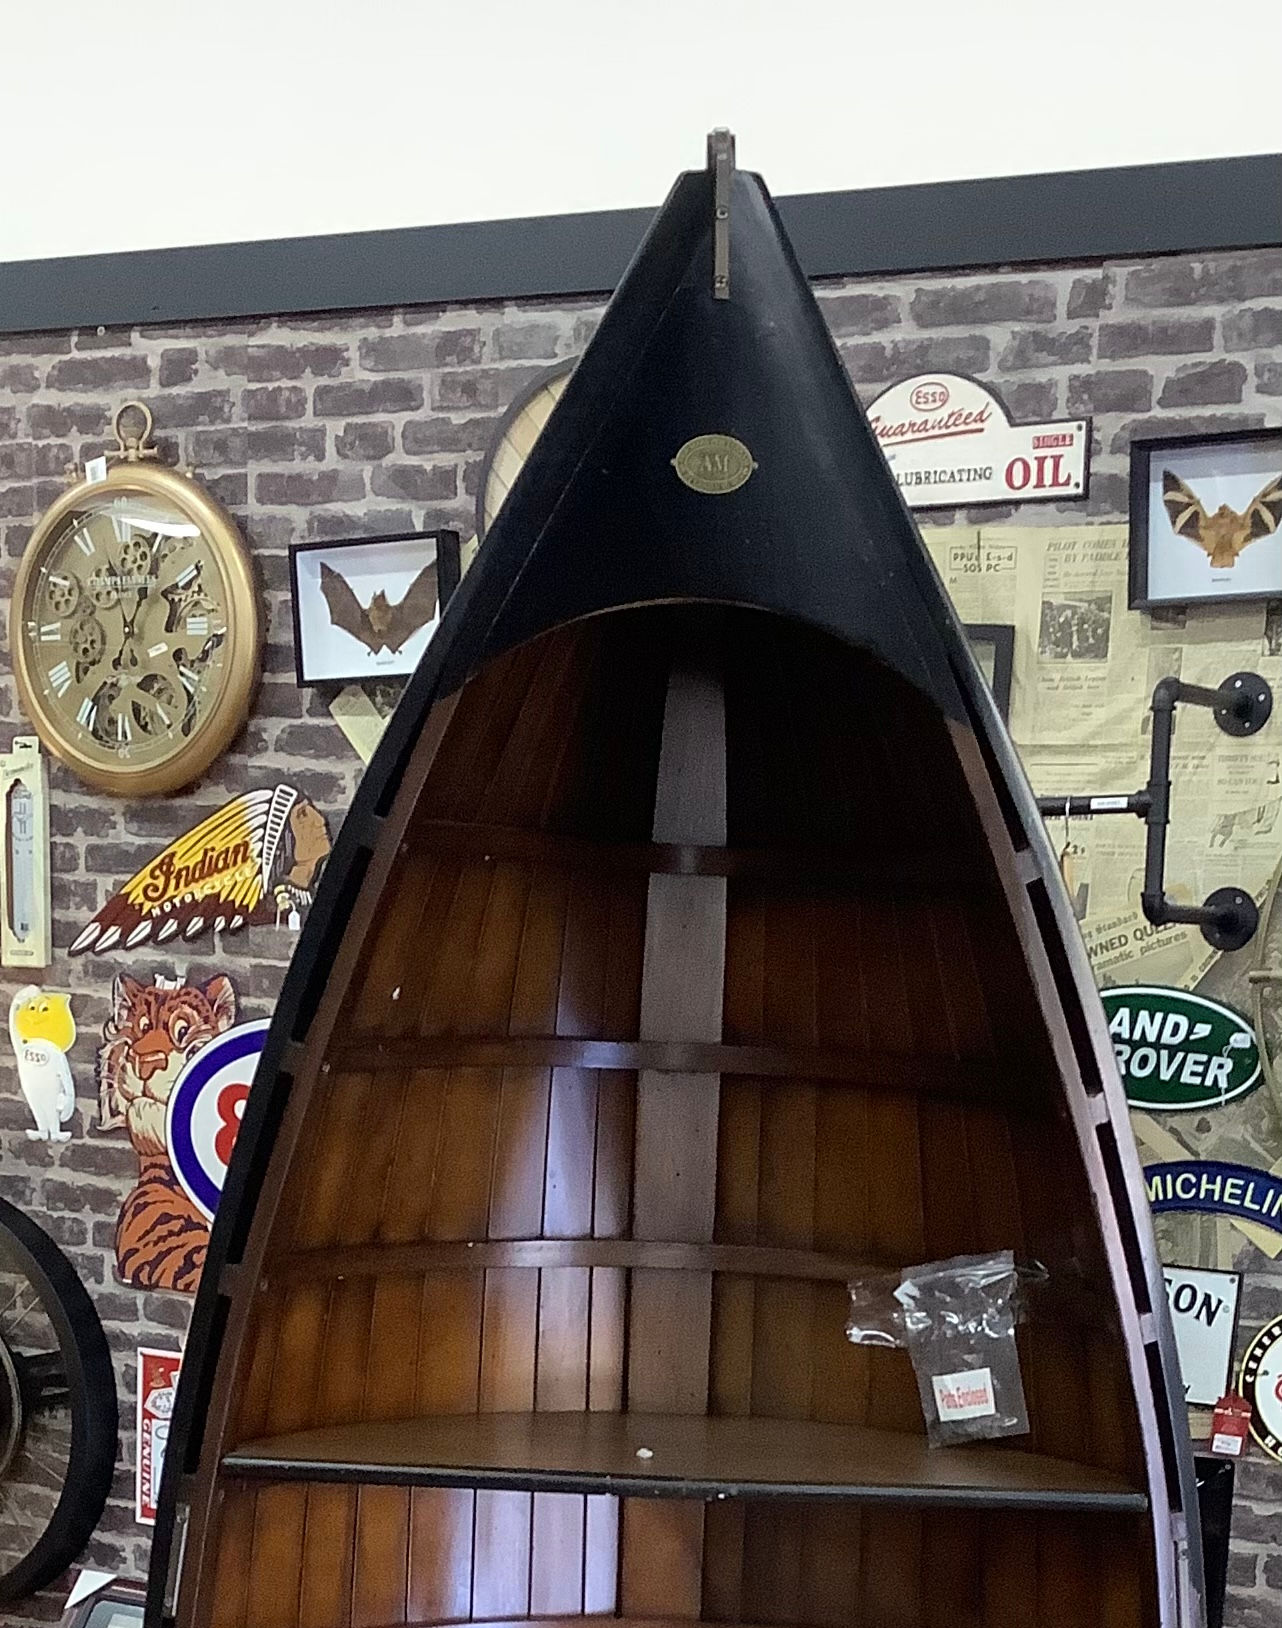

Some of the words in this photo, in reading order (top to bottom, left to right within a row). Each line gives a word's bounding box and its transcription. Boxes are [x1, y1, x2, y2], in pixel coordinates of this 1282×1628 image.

[896, 467, 993, 486] LUBRICATING
[1005, 454, 1072, 490] OIL
[142, 840, 249, 903] Indian
[1089, 934, 1128, 959] WNED
[1096, 950, 1134, 971] amatic
[1140, 931, 1187, 955] pictures
[1109, 1007, 1189, 1046] AND
[142, 1418, 152, 1507] GENUINE
